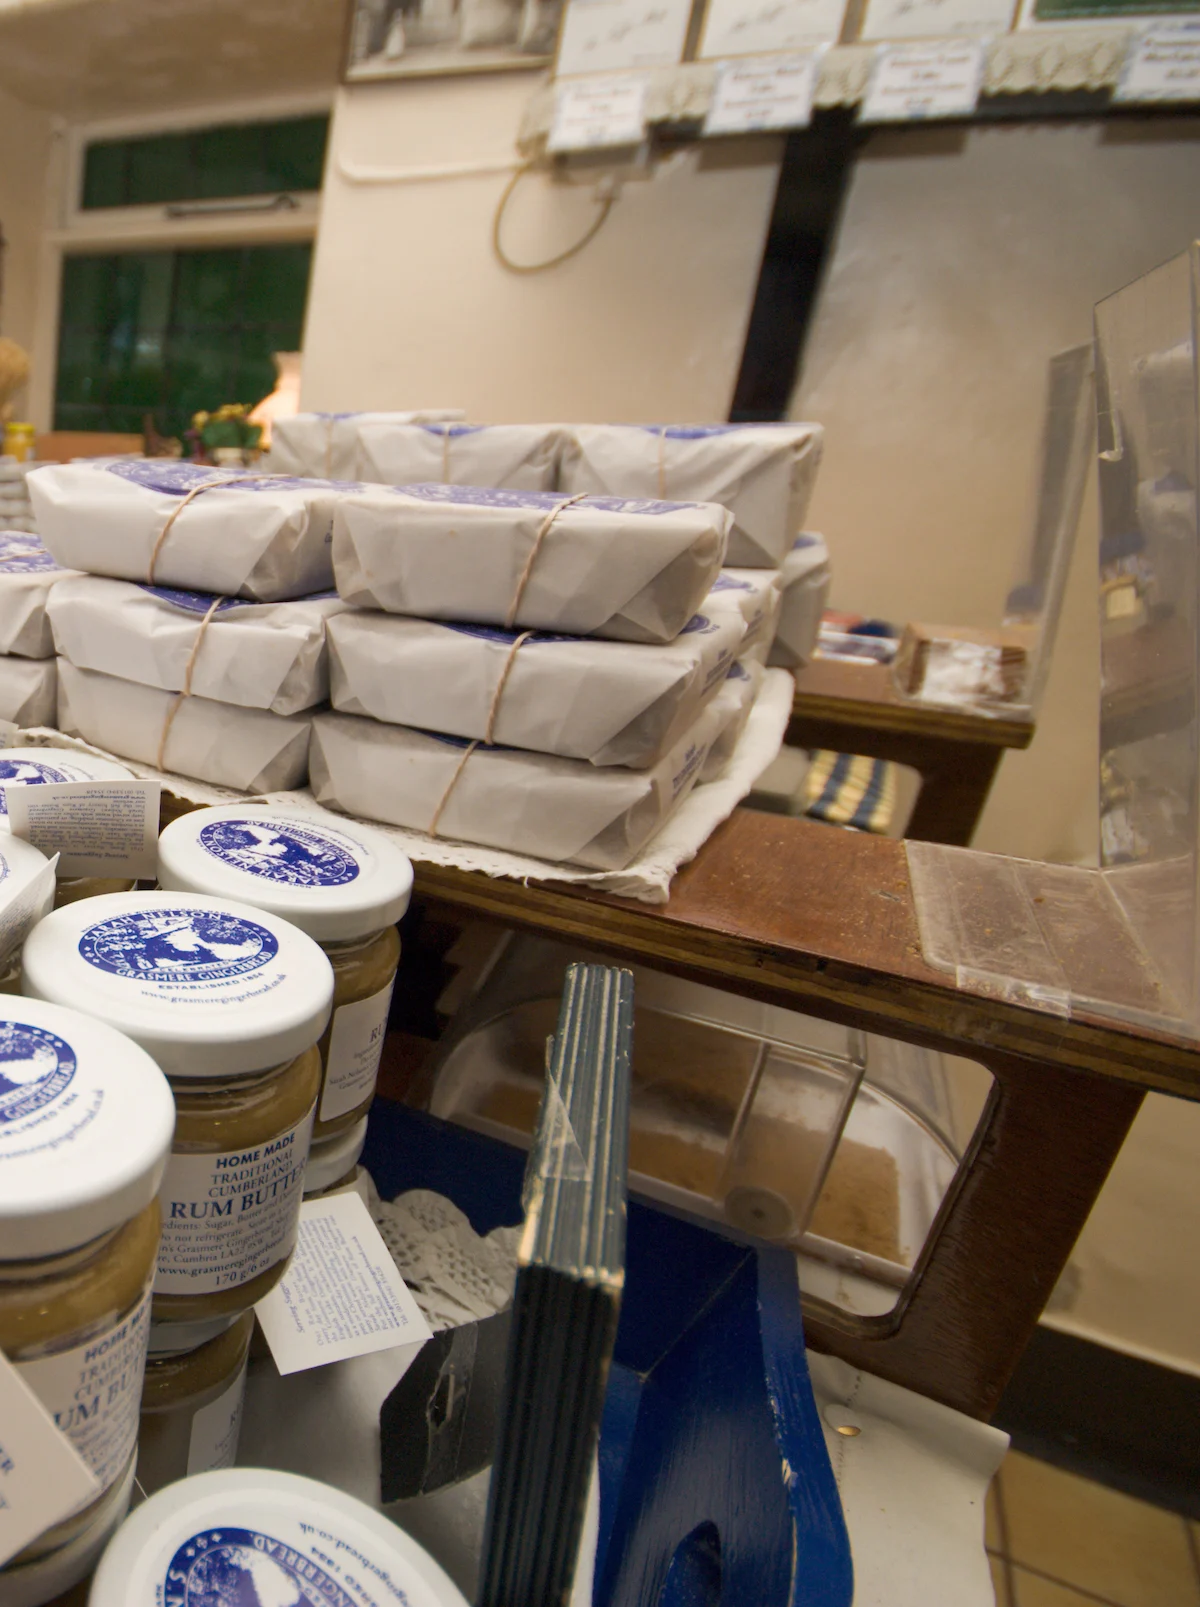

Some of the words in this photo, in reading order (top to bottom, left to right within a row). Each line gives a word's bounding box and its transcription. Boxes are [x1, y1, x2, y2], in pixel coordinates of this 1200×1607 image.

[202, 833, 250, 869] NELSON'S
[259, 869, 322, 886] SARAH
[84, 916, 131, 942] SARAH
[143, 911, 242, 924] NELSON'S
[116, 968, 194, 983] GRASMERE
[160, 960, 230, 972] CELEBRATED
[141, 972, 288, 1005] www.grasmeregingerbread.co.uk
[158, 980, 240, 990] ESTABLISHED
[242, 972, 266, 982] 1854
[216, 1151, 260, 1169] HOME
[264, 1133, 295, 1157] MADE
[211, 1149, 293, 1185] TRADITIONAL
[208, 1161, 293, 1198] CUMBERLAND
[169, 1199, 234, 1219] RUM
[175, 1234, 191, 1242] not
[178, 1245, 224, 1253] Grasmere
[174, 1255, 217, 1263] Cumbria
[216, 1272, 237, 1286] 170
[309, 1546, 342, 1573] 1854
